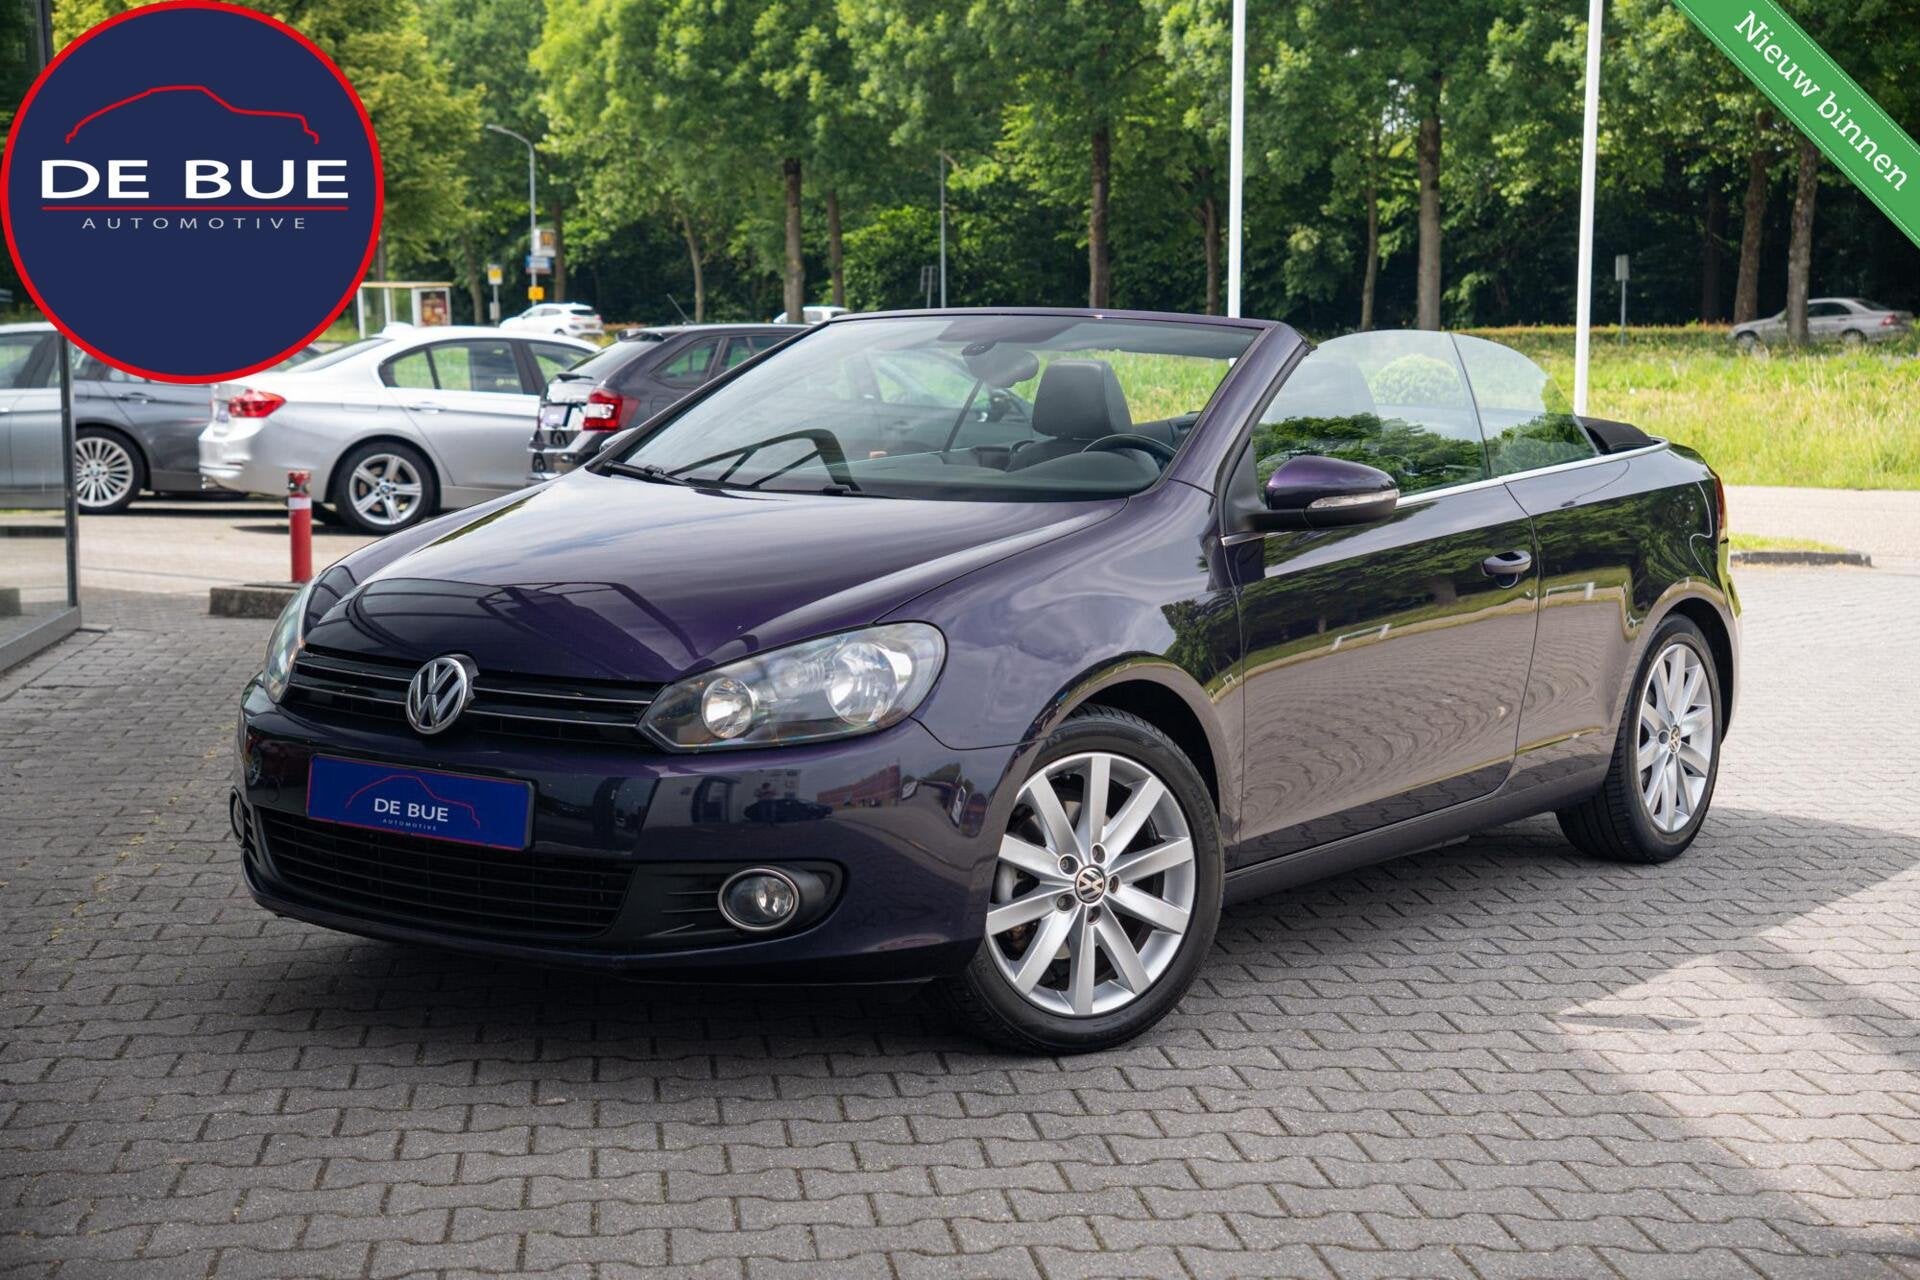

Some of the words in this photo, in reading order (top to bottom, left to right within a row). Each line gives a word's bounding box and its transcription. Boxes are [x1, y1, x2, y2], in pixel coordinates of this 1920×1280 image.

[374, 798, 400, 815] DE
[407, 803, 448, 822] BUE
[383, 819, 436, 831] AUTOMOTIVE
